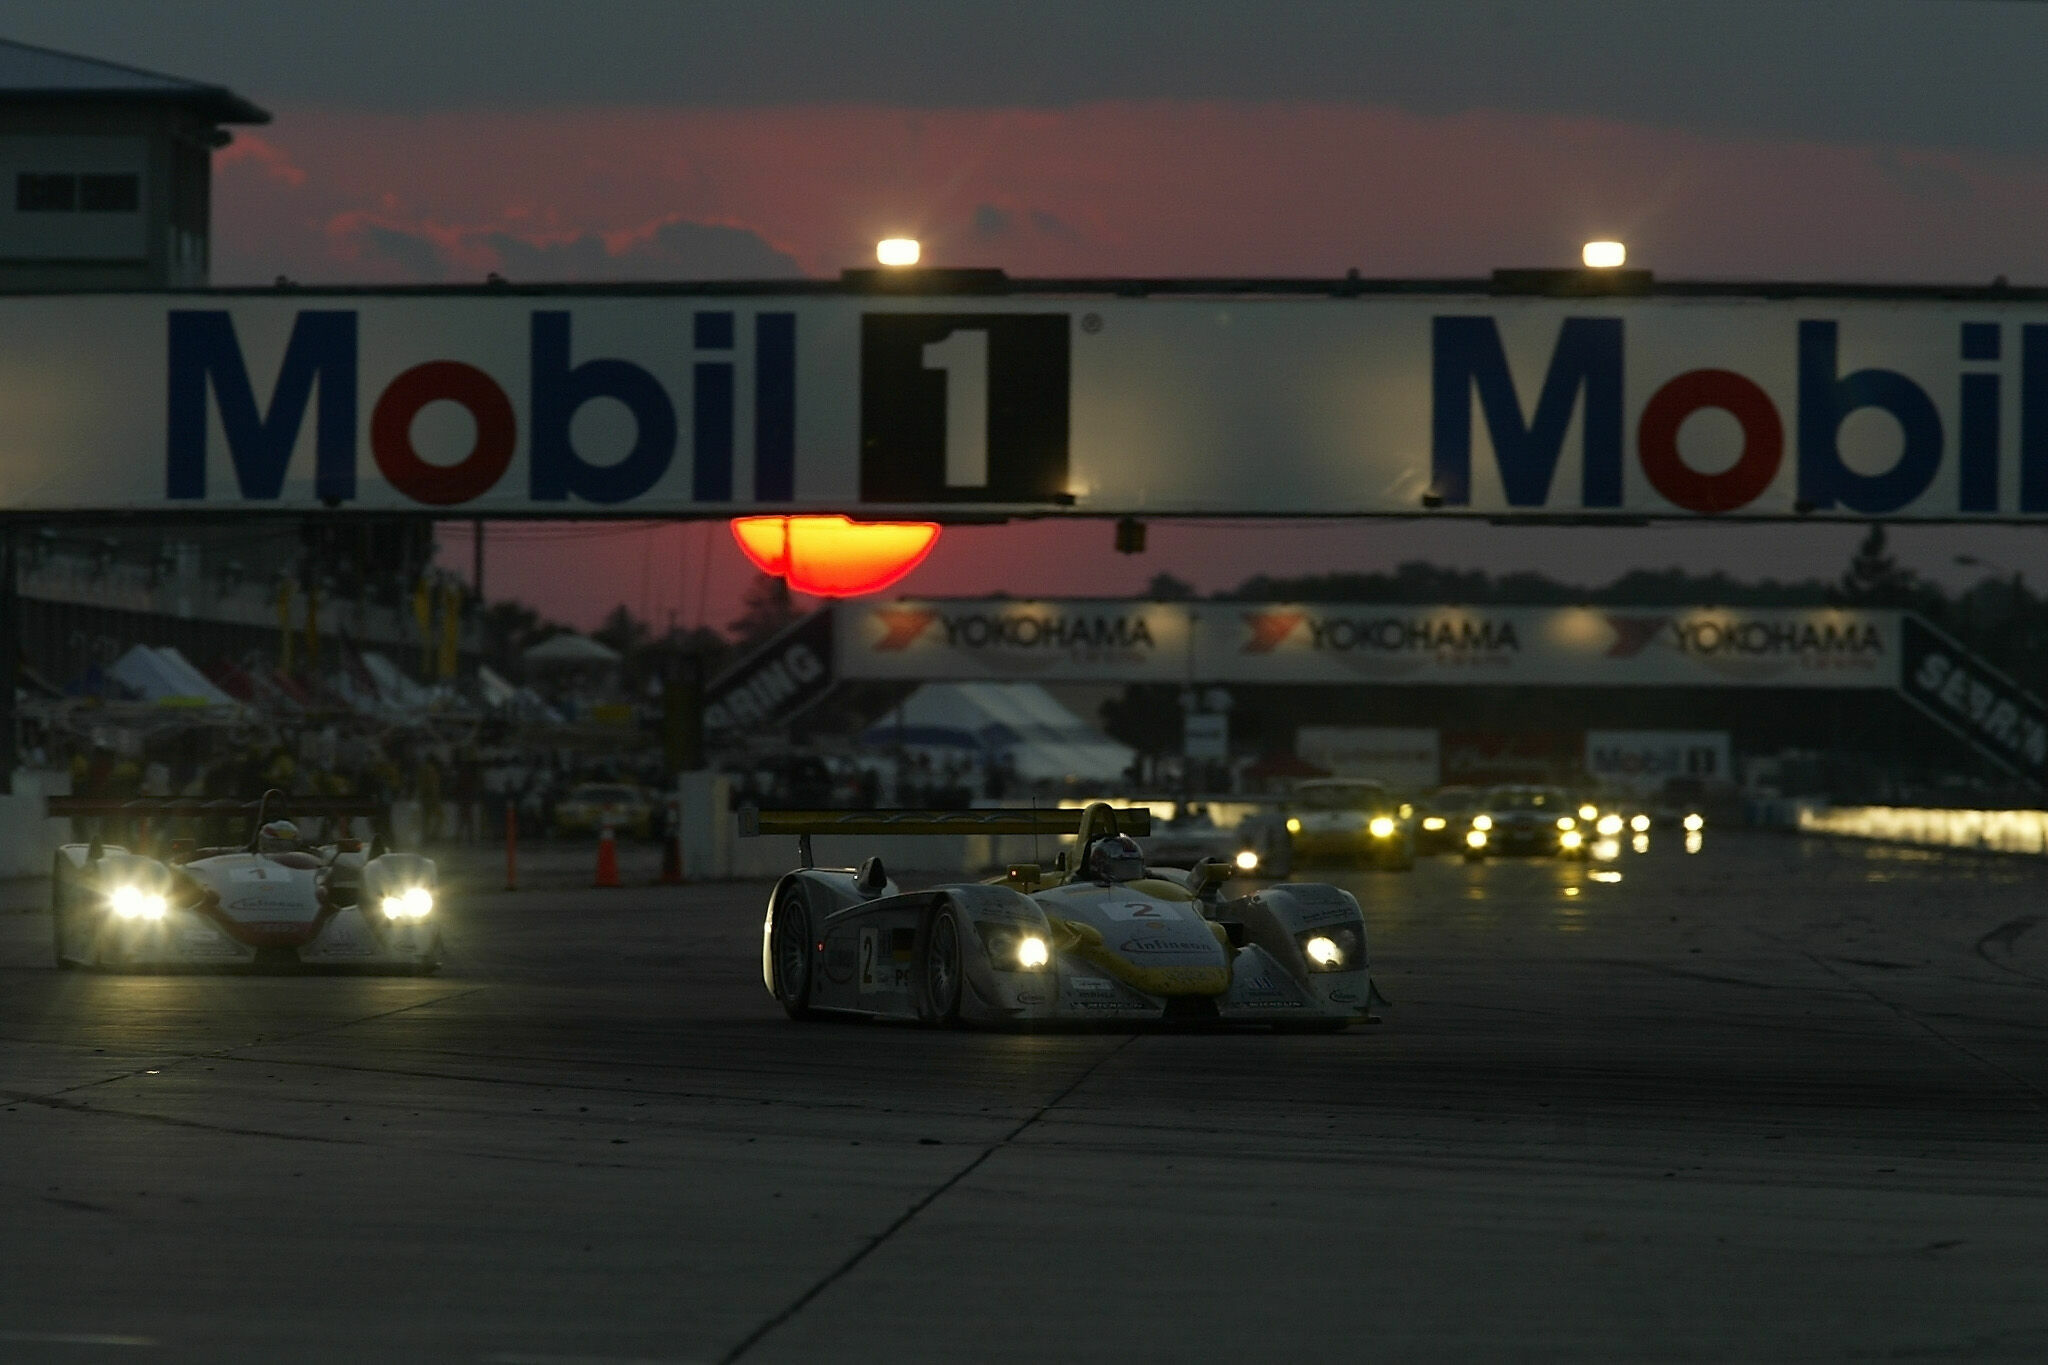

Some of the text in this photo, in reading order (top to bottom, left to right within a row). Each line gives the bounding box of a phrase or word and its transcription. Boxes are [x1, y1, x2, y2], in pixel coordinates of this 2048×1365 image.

[167, 310, 990, 507] Mobil 1
[1432, 315, 2048, 515] Mobil
[943, 615, 1154, 648] YOKOHAMA
[1309, 618, 1520, 652] YOKOHAMA
[1672, 621, 1885, 654] YOKOHAMA
[1124, 903, 1161, 917] 2
[863, 935, 873, 984] 2
